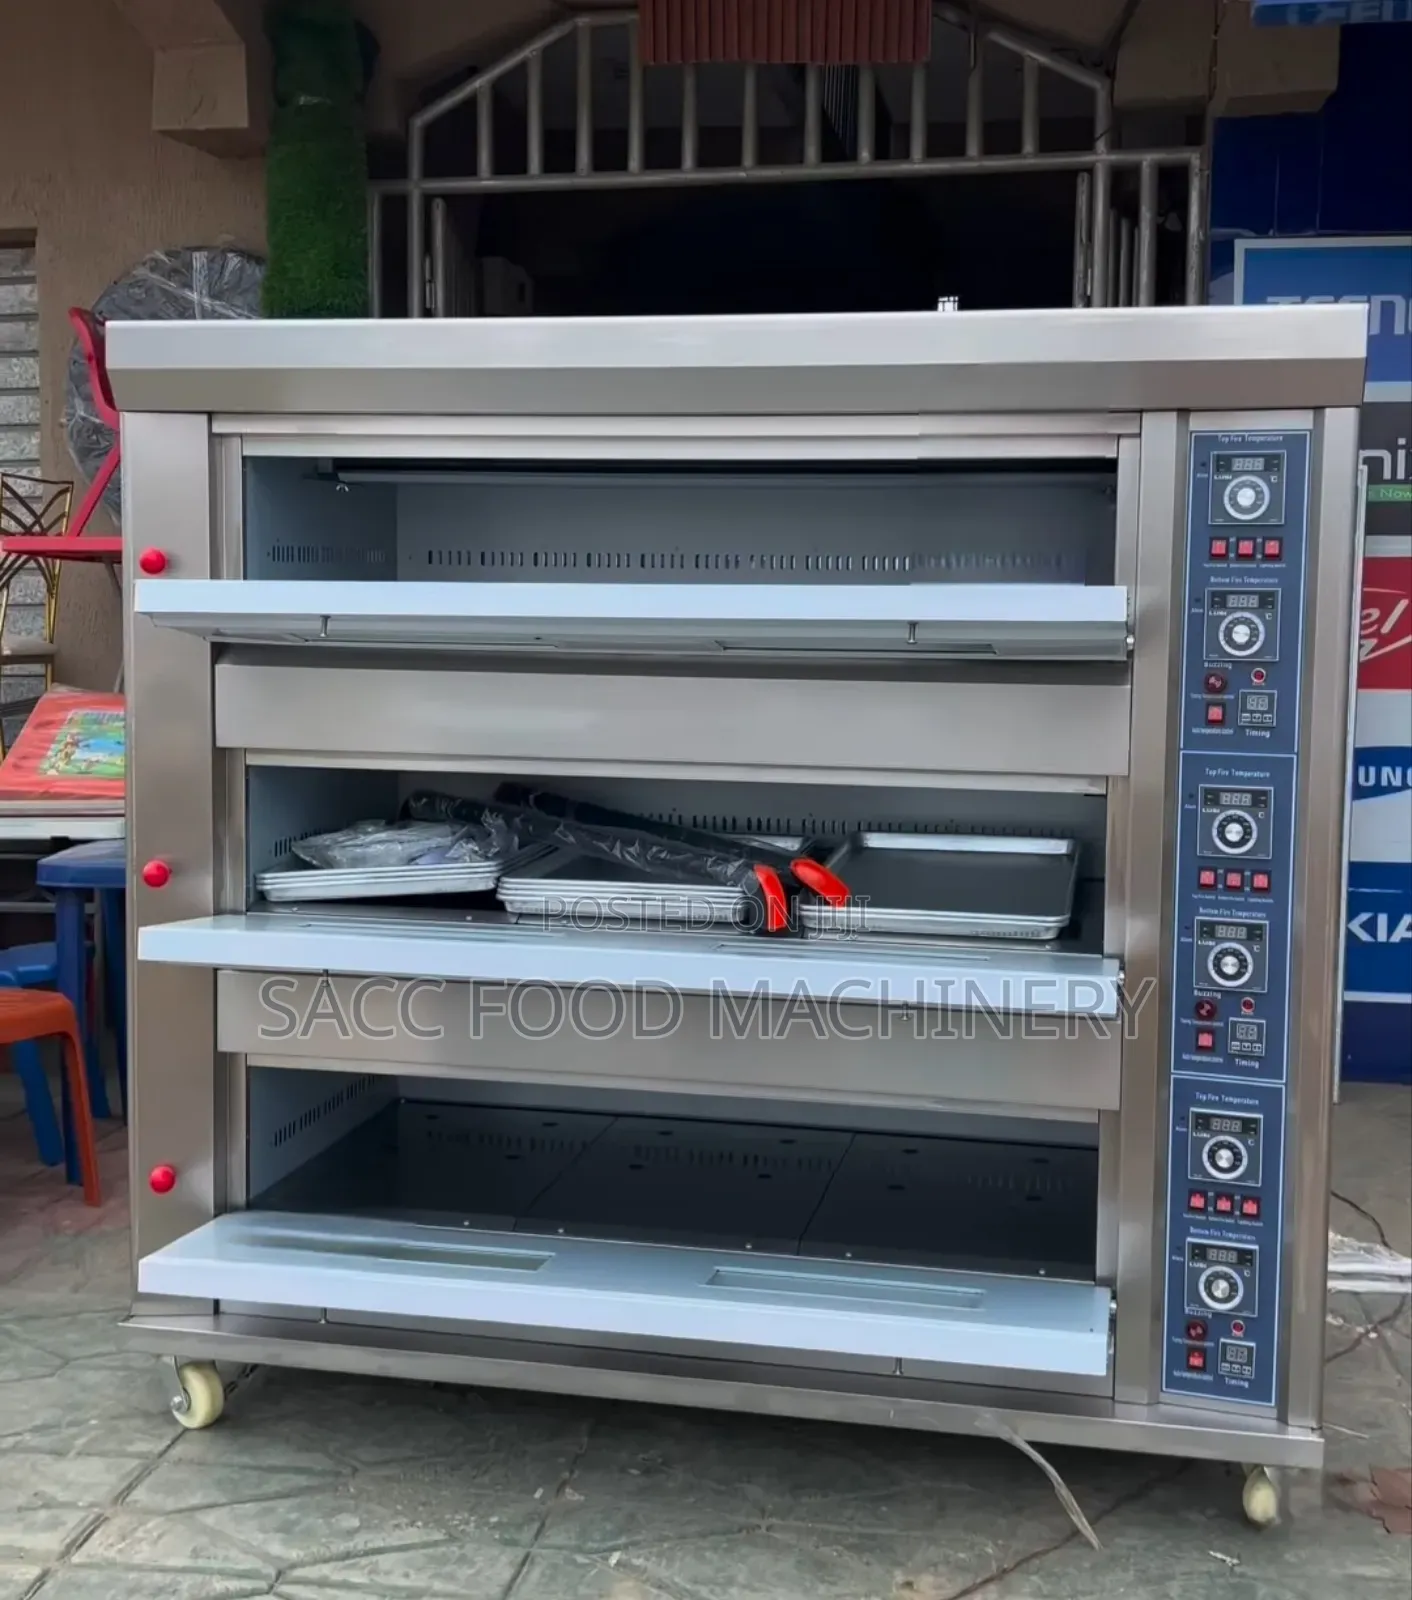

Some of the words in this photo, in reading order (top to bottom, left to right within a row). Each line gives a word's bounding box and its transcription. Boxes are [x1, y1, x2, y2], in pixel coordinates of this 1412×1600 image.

[1245, 729, 1270, 738] Timing
[1205, 768, 1216, 777] Top
[1231, 769, 1270, 778] Temperature
[1234, 1058, 1260, 1069] Timing
[1195, 1092, 1207, 1101] Top
[1221, 1095, 1259, 1105] Temperature
[1224, 1377, 1249, 1388] Timing
